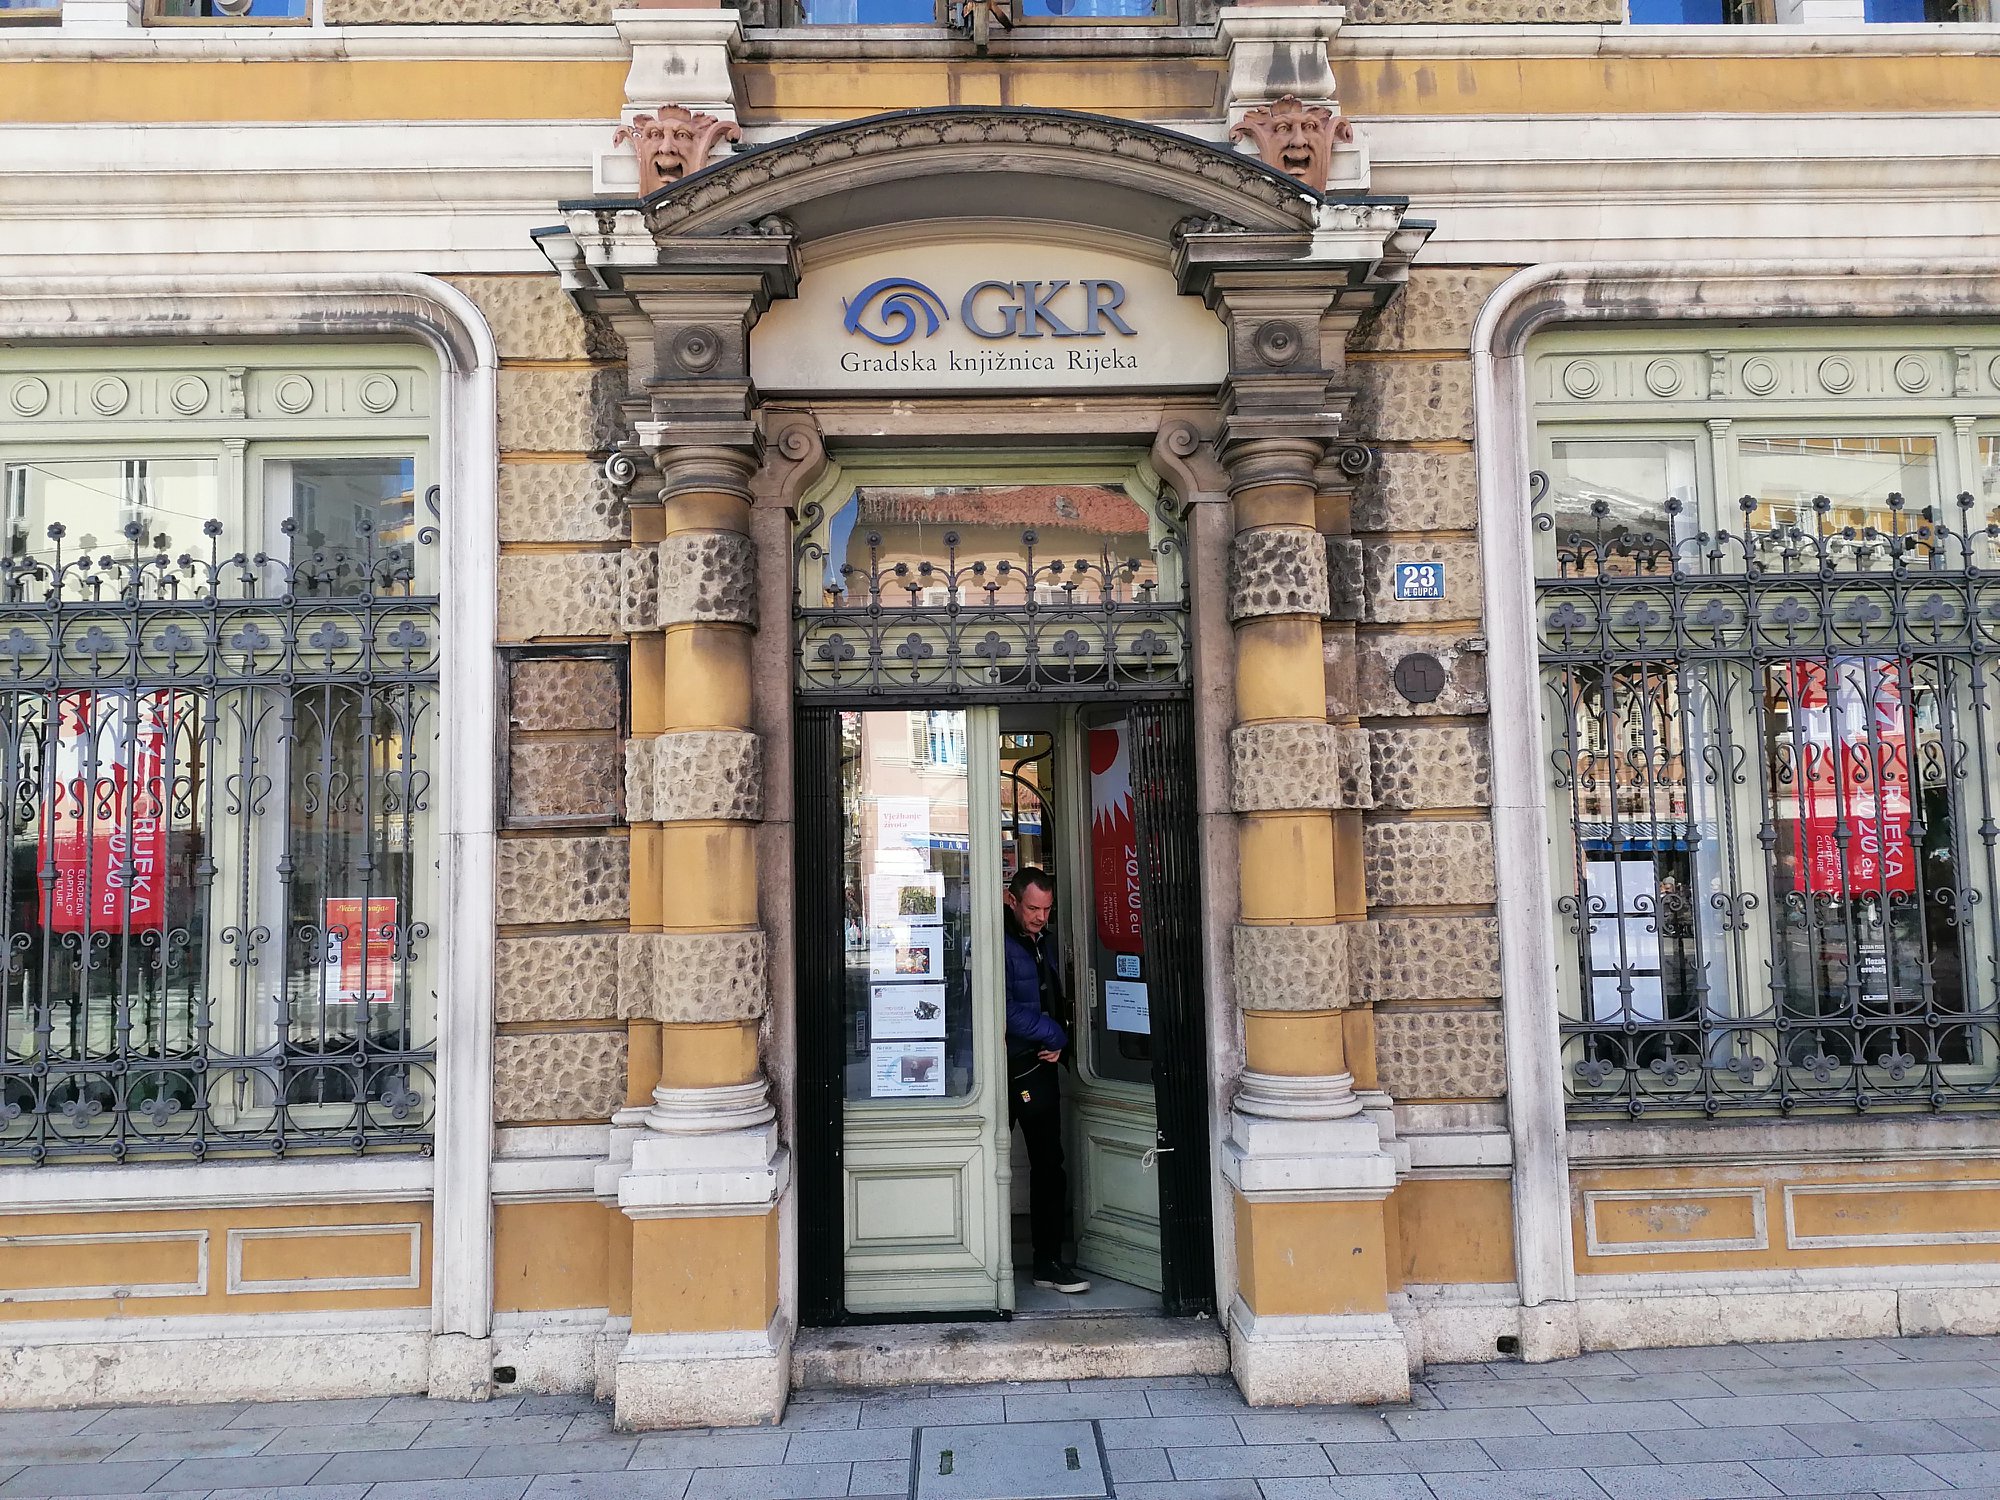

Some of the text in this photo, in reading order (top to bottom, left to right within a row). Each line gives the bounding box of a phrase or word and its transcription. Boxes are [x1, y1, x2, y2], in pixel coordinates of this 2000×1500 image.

[961, 280, 1138, 339] GKR
[840, 348, 1138, 376] Gradska knjižnica Rijeka
[1403, 566, 1435, 587] 23
[1413, 587, 1438, 597] GUPCA
[1816, 835, 1824, 872] CULTURE
[1882, 785, 1904, 879] RIJEKA
[131, 818, 155, 914] RIJEKA
[65, 868, 74, 917] CAPITAL OF
[76, 868, 85, 915] EUROPEAN
